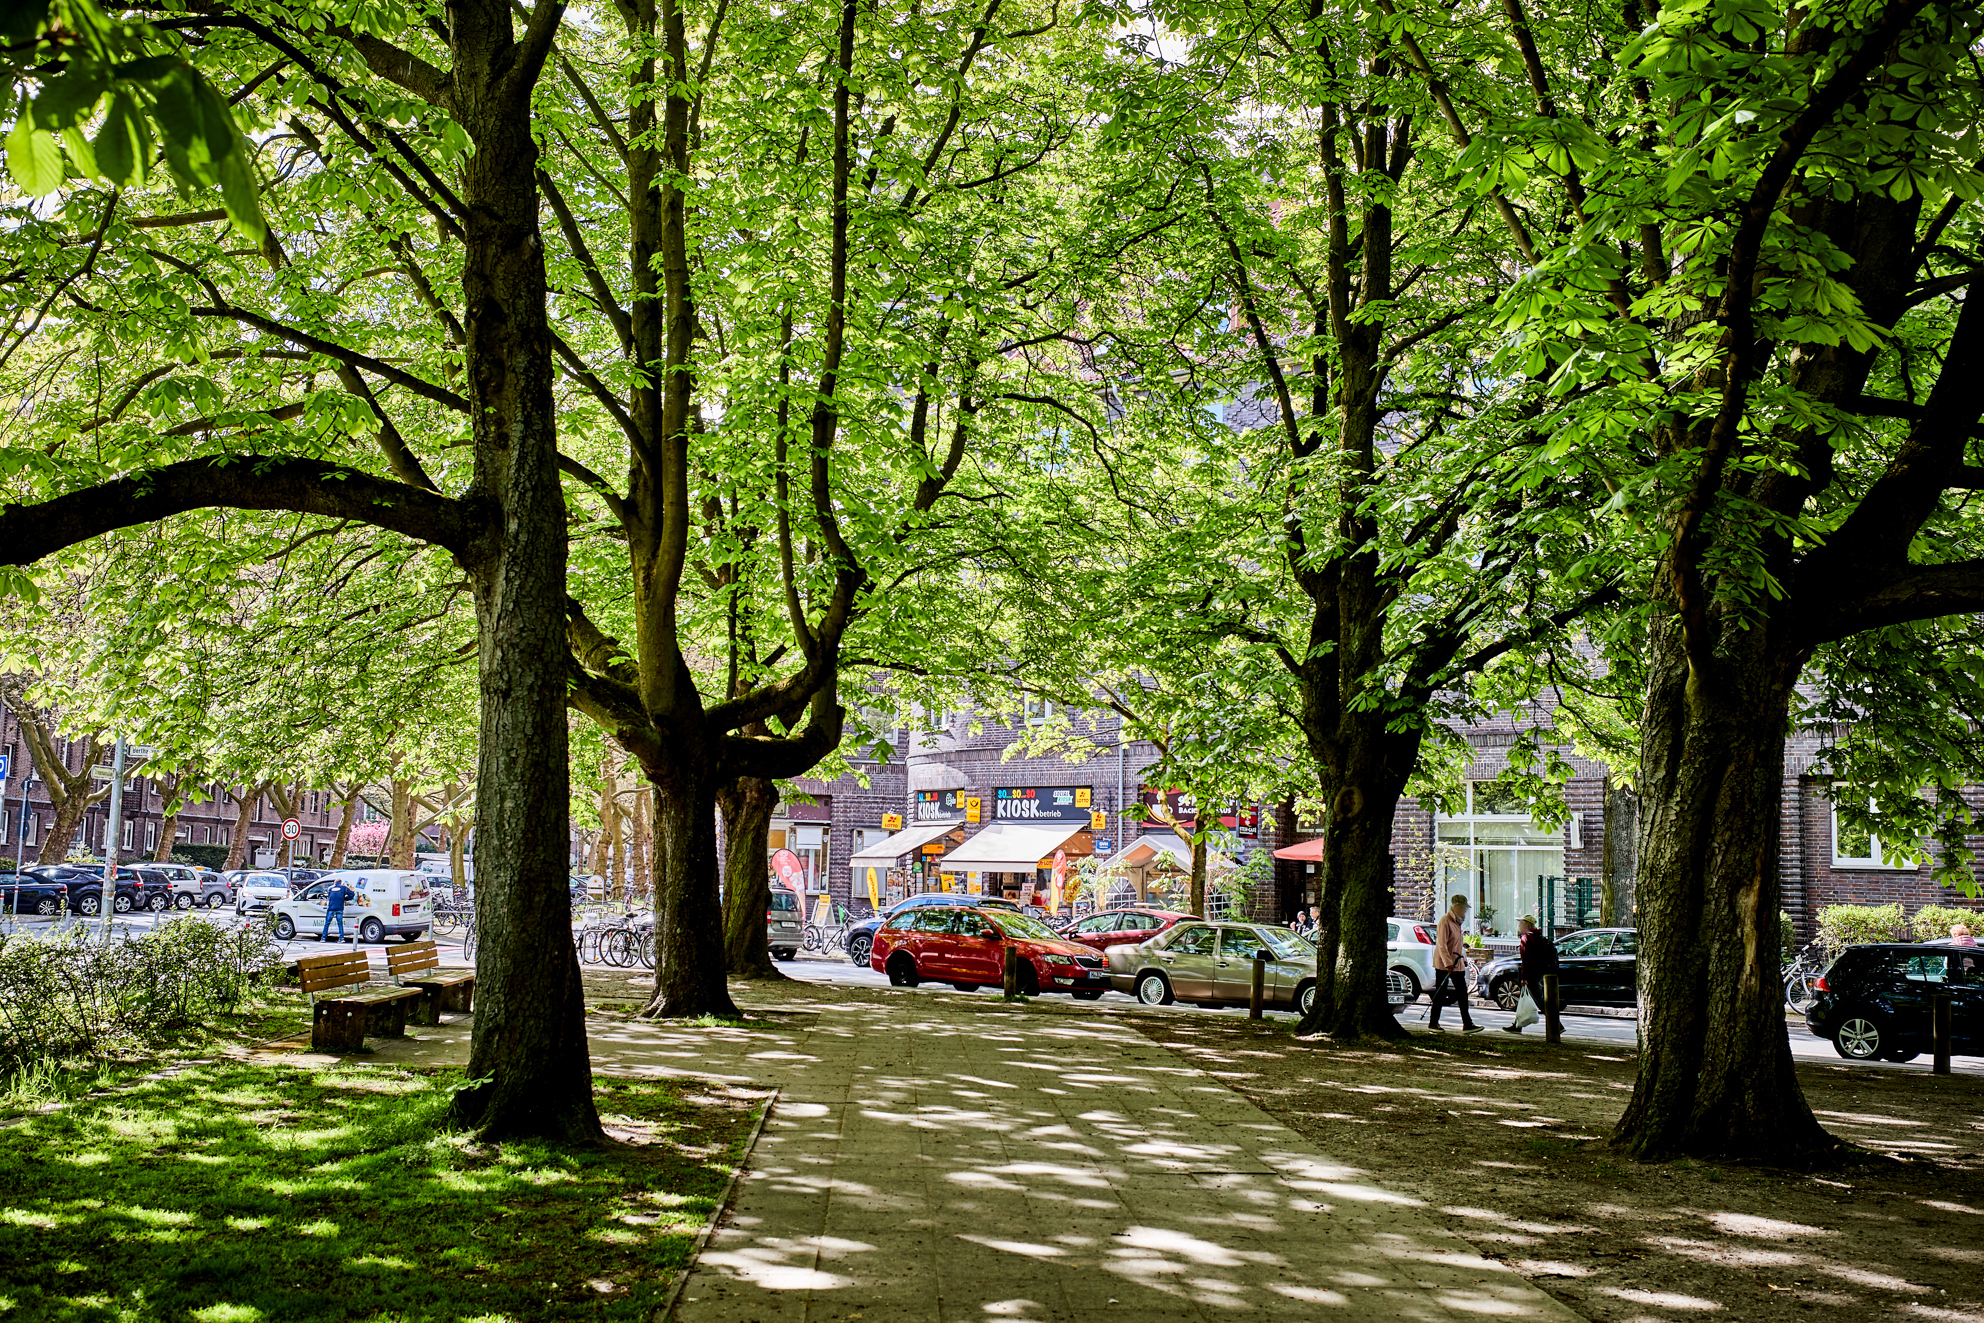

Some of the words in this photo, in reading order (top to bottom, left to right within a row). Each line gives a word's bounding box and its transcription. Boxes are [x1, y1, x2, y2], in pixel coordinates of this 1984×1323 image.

[998, 789, 1007, 799] SO
[1012, 789, 1022, 799] SO
[1026, 789, 1036, 799] SO
[918, 801, 941, 819] KIOSK
[997, 799, 1040, 818] KIOSK
[285, 824, 297, 834] 30
